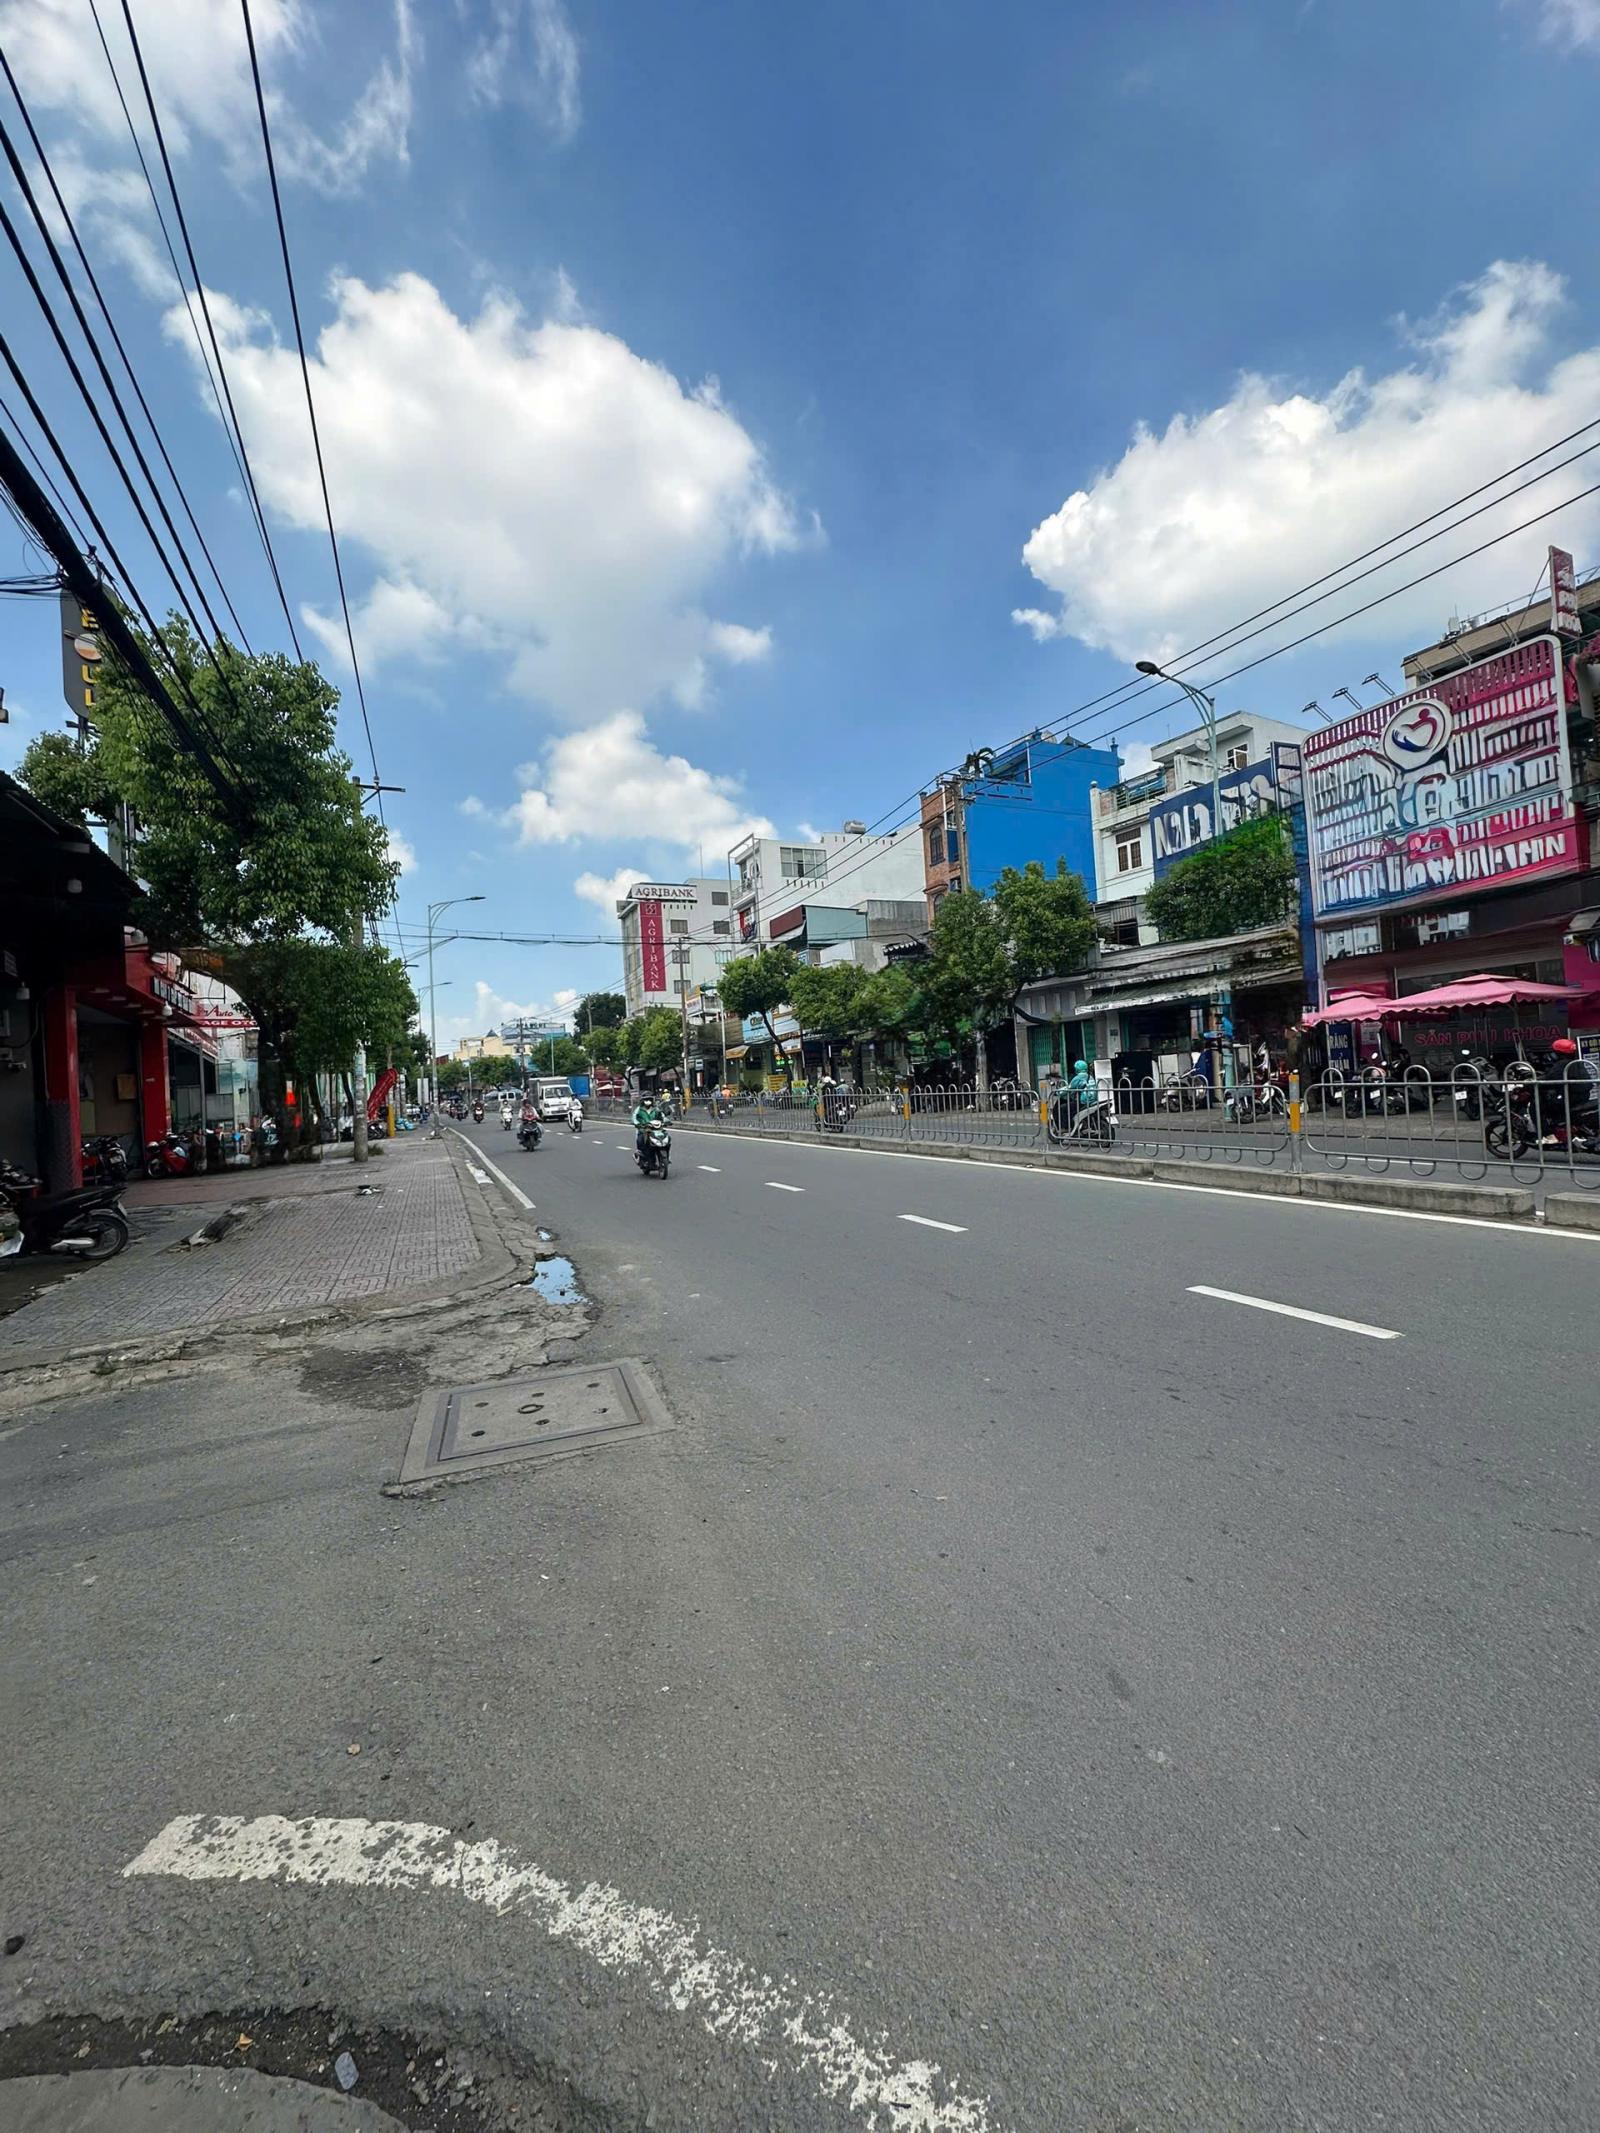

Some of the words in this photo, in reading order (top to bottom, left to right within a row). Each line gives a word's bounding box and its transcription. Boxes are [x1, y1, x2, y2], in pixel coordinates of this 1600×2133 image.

[79, 600, 100, 707] EOUL
[635, 888, 695, 898] AGRIBANK
[648, 919, 660, 989] AGRIBANK
